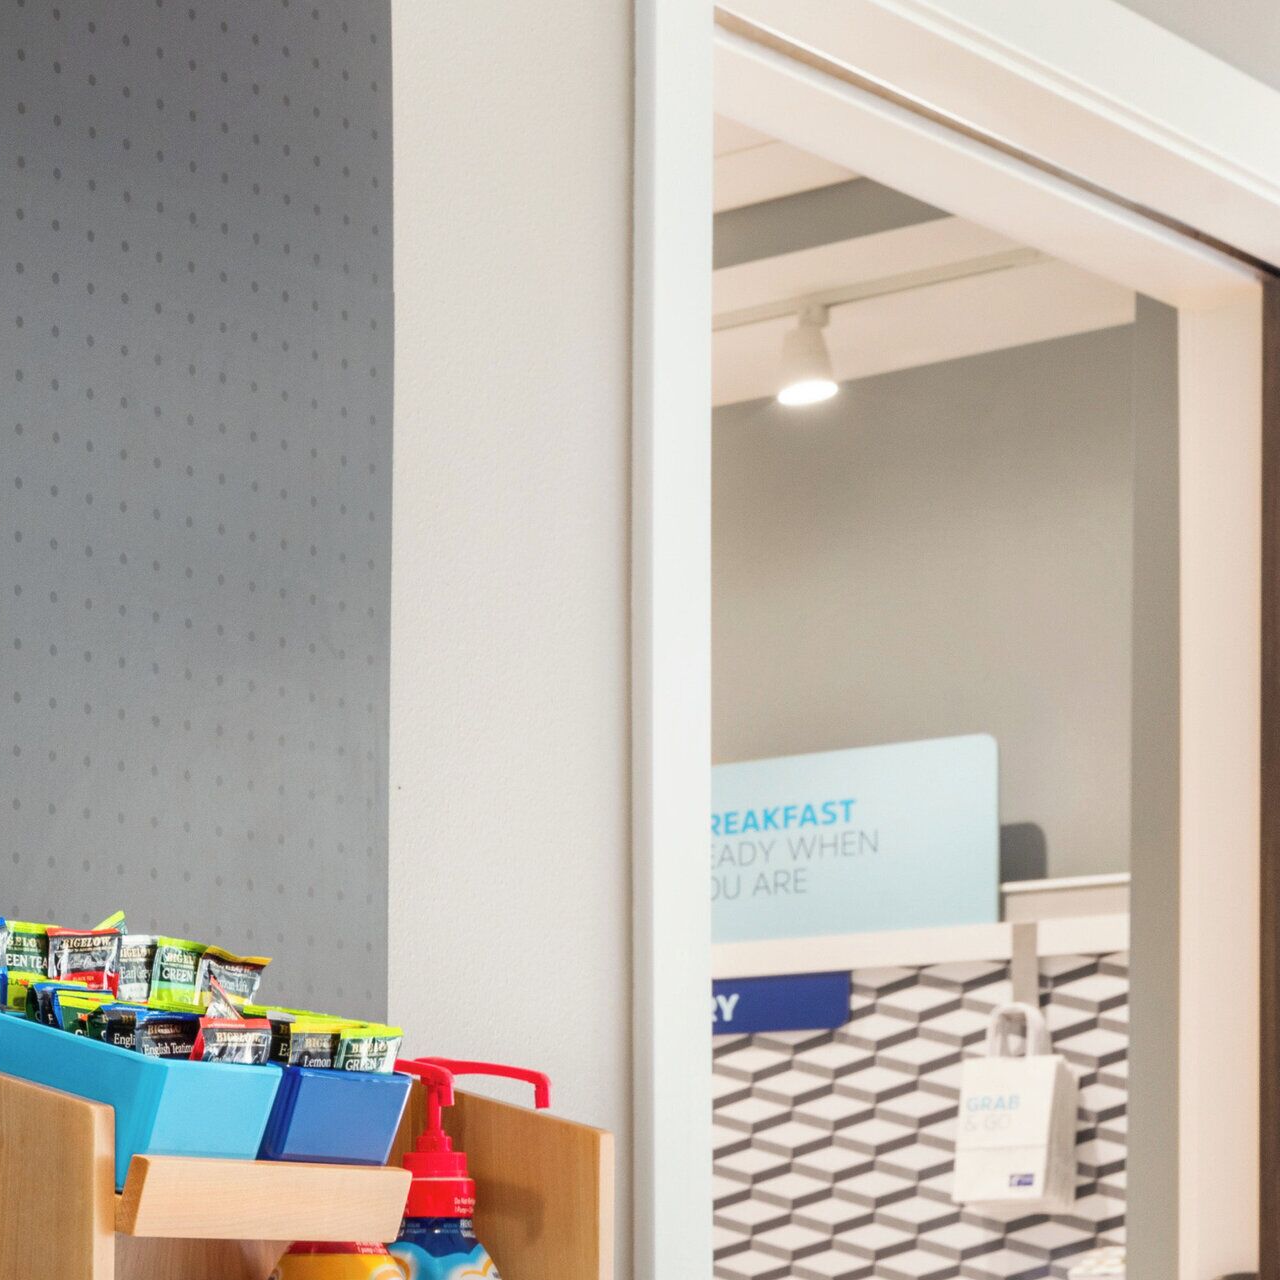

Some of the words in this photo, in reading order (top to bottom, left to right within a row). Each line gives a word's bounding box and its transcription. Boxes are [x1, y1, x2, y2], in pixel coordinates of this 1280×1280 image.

[711, 797, 856, 837] REAKFAST
[787, 829, 879, 861] WHEN
[752, 867, 808, 897] ARE
[62, 936, 112, 949] BIGELOW
[30, 955, 48, 969] TEA
[162, 966, 194, 982] GREEN
[113, 1033, 136, 1048] Engli
[143, 1042, 170, 1056] English
[303, 1056, 332, 1068] Lemon
[966, 1094, 1020, 1112] GRAB
